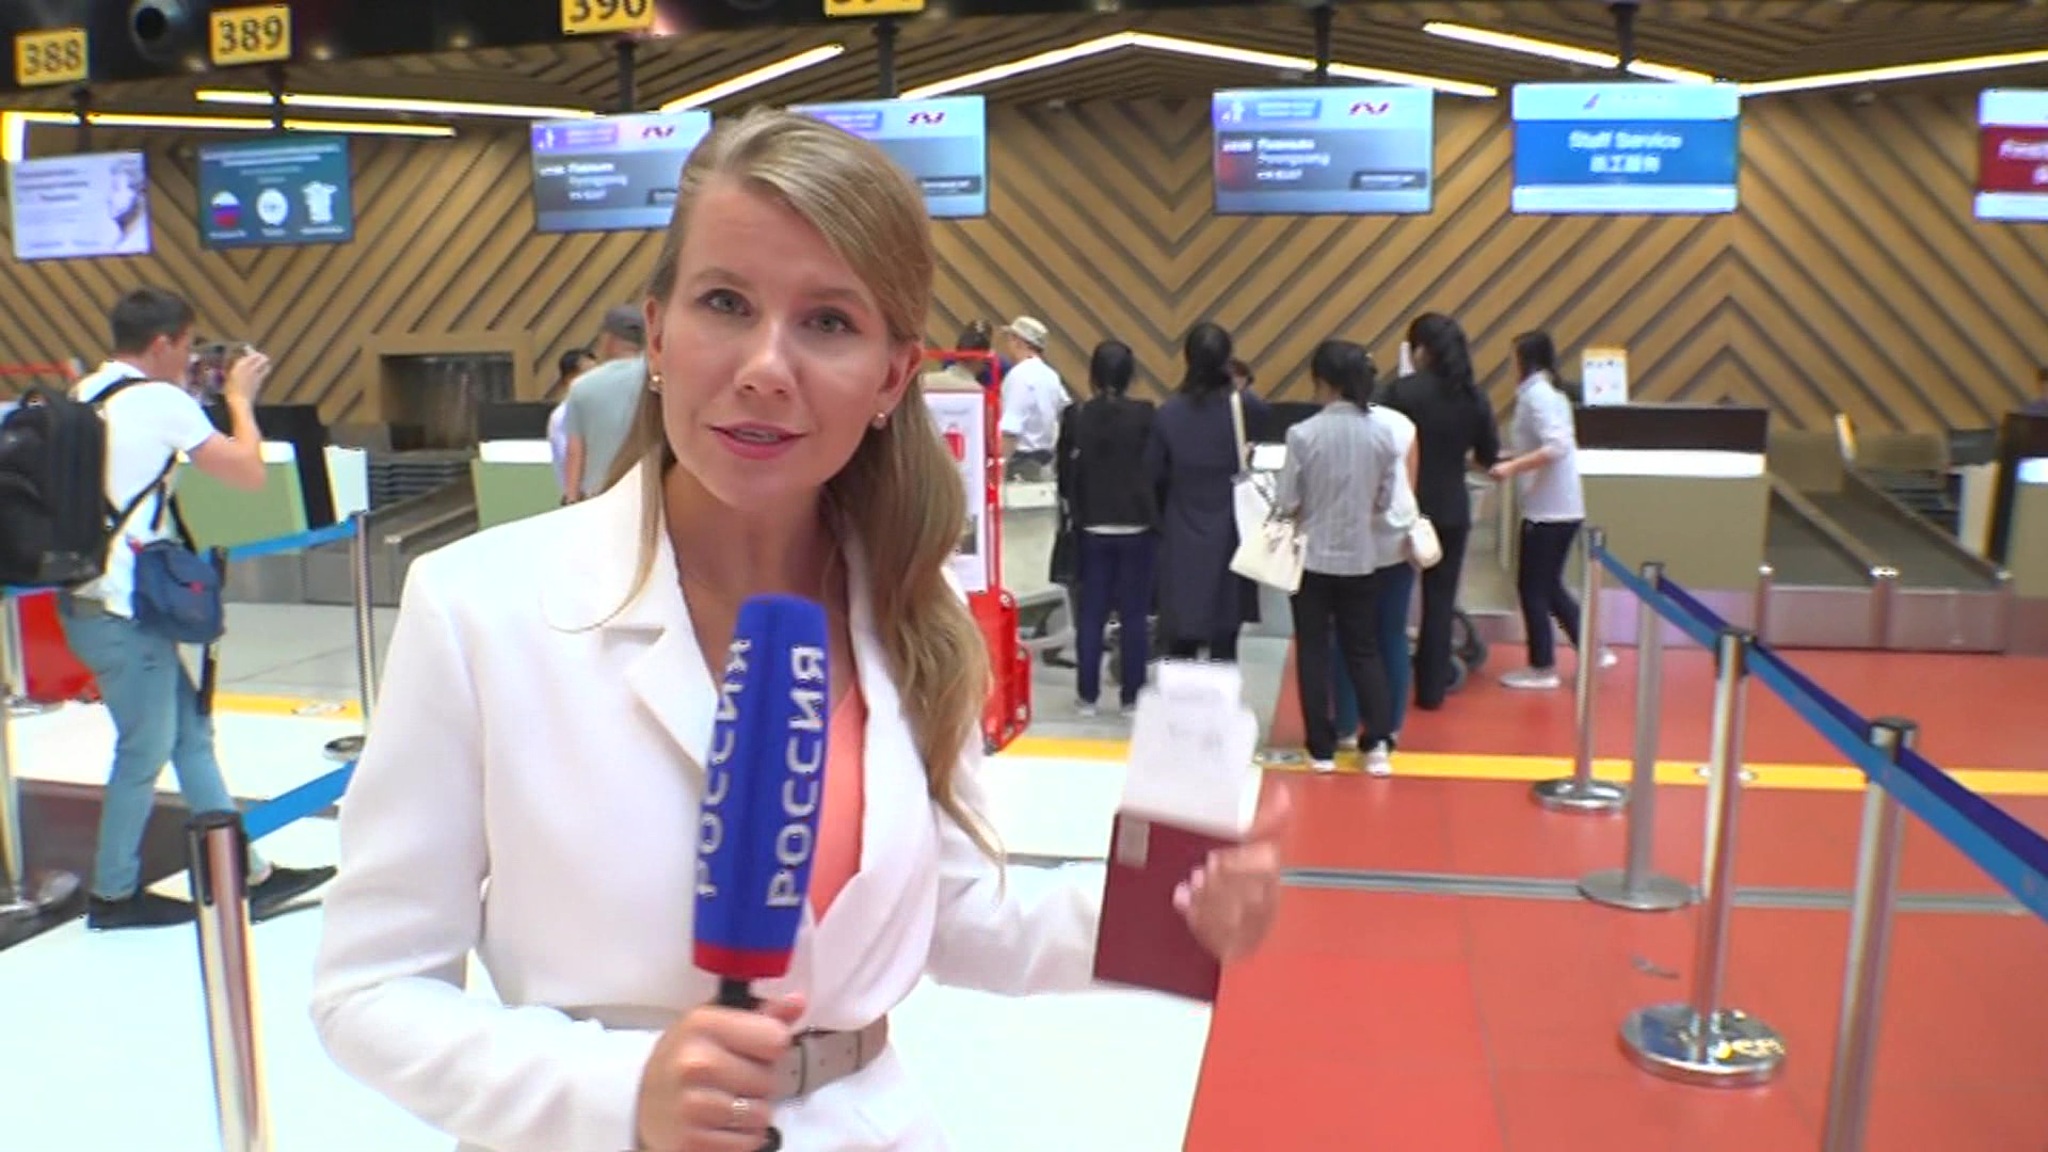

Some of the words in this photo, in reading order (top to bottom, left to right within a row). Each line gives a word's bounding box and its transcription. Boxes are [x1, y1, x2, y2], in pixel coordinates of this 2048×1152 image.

[218, 15, 284, 53] 389
[25, 39, 81, 75] 388
[1568, 130, 1613, 150] Staff
[1614, 130, 1684, 149] Service
[765, 645, 826, 909] РОССИЯ
